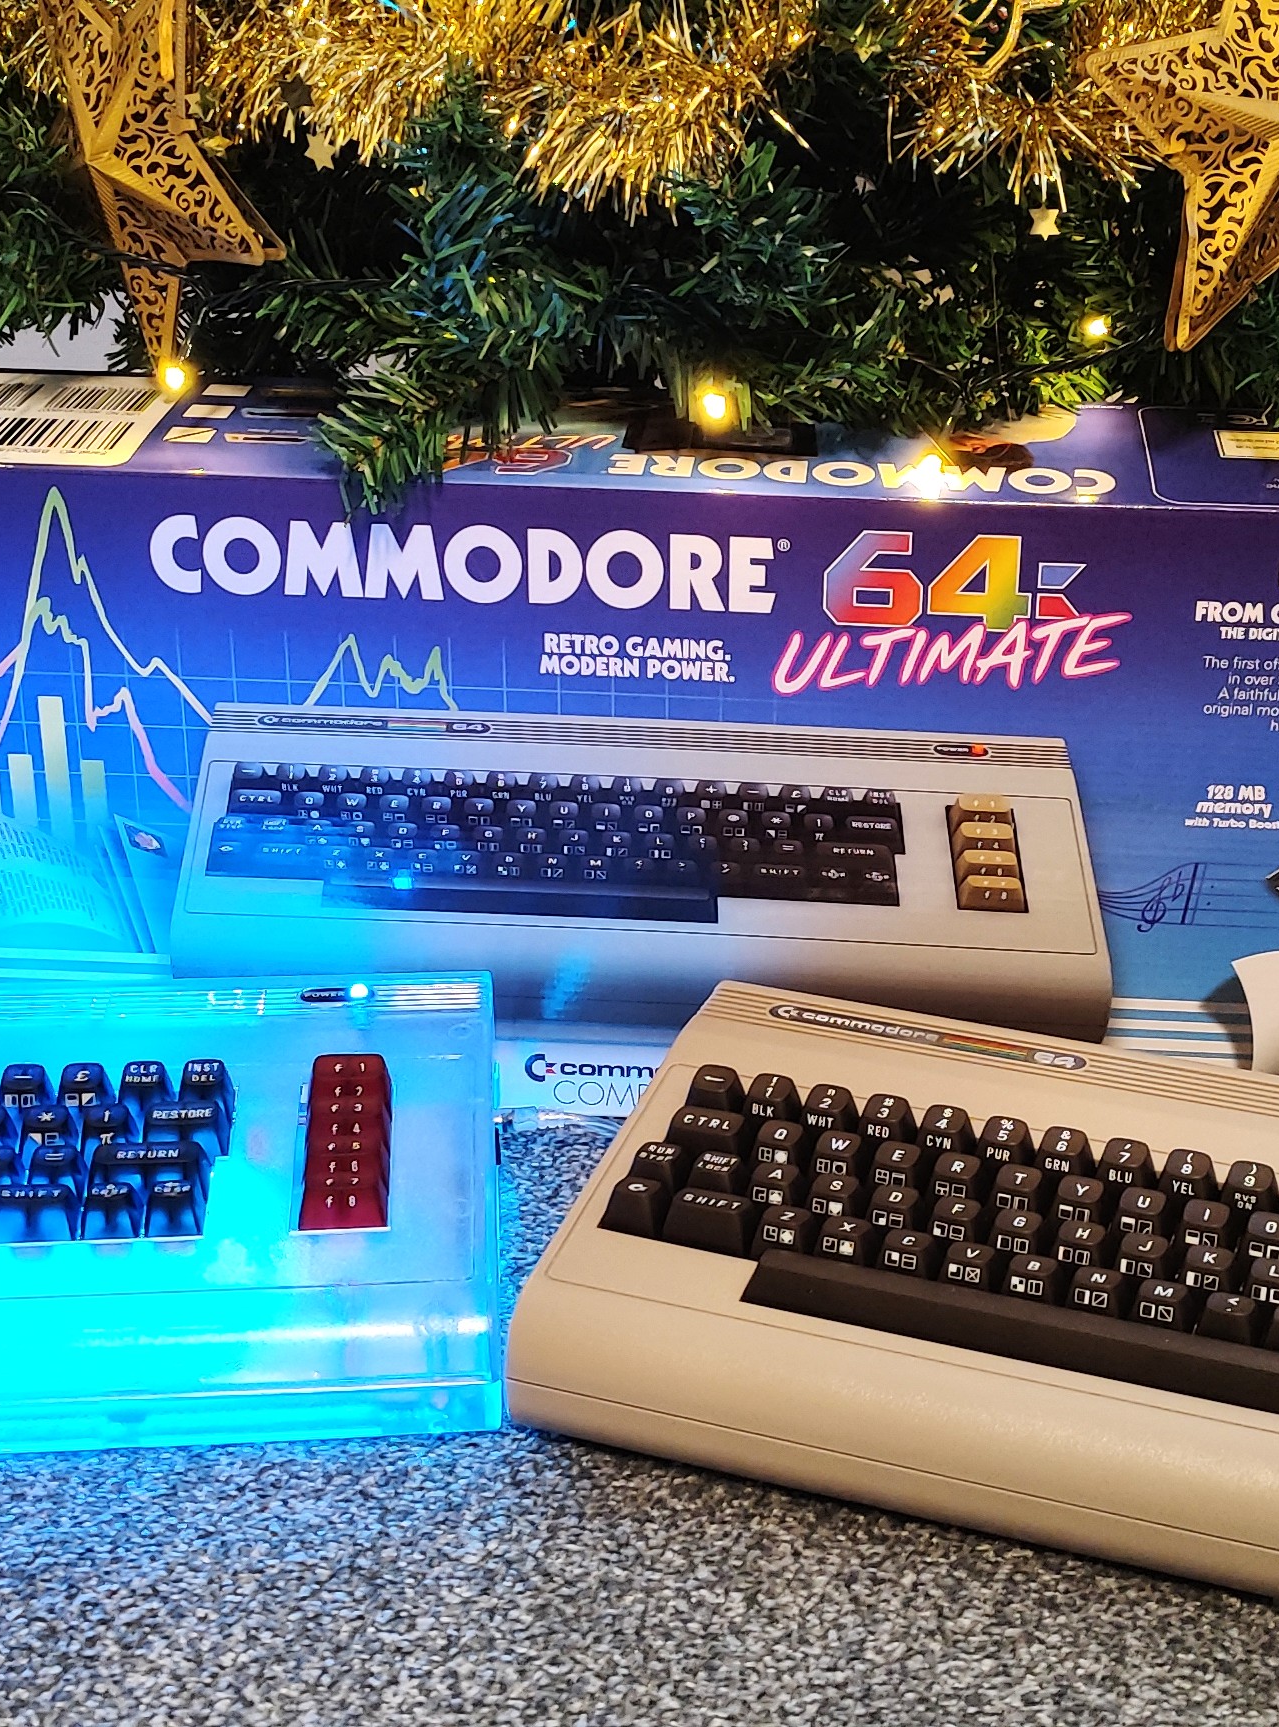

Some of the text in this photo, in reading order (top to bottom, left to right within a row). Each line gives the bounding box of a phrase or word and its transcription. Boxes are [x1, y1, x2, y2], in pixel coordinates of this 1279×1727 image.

[822, 529, 1030, 632] 64
[1195, 600, 1264, 624] FROM
[1220, 626, 1245, 640] THE
[542, 632, 733, 662] RETRO GAMING.
[771, 612, 1133, 696] ULTIMATE
[539, 654, 736, 683] MODERN POWER.
[1203, 655, 1229, 670] The
[1233, 656, 1260, 671] first
[1228, 673, 1240, 686] in
[1244, 676, 1275, 687] over
[1217, 687, 1229, 700] A
[1203, 703, 1253, 719] original
[452, 722, 486, 732] 64
[1206, 784, 1266, 801] 128 MB
[1195, 801, 1273, 819] memory
[1184, 817, 1210, 827] with
[1212, 818, 1246, 828] Turbo
[802, 1011, 1077, 1069] commodore 64
[129, 1064, 159, 1074] CLR
[187, 1063, 219, 1073] INST
[191, 1074, 216, 1083] DEL
[152, 1108, 214, 1120] RESTORE
[751, 1102, 775, 1117] BLK
[683, 1114, 731, 1131] CTRL
[806, 1113, 835, 1129] WHT
[774, 1128, 788, 1140] Q
[866, 1123, 890, 1139] RED
[831, 1137, 851, 1151] W
[926, 1134, 952, 1150] CYN
[116, 1149, 179, 1161] RETURN
[647, 1144, 676, 1155] RUN
[891, 1149, 905, 1162] E
[985, 1146, 1011, 1162] PUR
[703, 1153, 738, 1166] SHIFT
[1044, 1157, 1070, 1173] GRN
[950, 1160, 966, 1173] R
[768, 1168, 784, 1181] A
[1014, 1172, 1028, 1185] T
[1108, 1168, 1133, 1184] BLU
[829, 1180, 844, 1192] S
[1075, 1183, 1090, 1197] Y
[1172, 1179, 1195, 1196] YEL
[1, 1189, 62, 1198] SHIFT
[888, 1191, 903, 1203] D
[1234, 1192, 1257, 1204] RVS
[683, 1192, 742, 1211] SHIFT
[1137, 1195, 1151, 1209] U
[1237, 1201, 1253, 1211] ON
[950, 1203, 966, 1215] F
[779, 1211, 796, 1222] Z
[1012, 1216, 1027, 1228] G
[839, 1221, 856, 1232] X
[1075, 1227, 1092, 1240] H
[901, 1236, 916, 1247] C
[1137, 1240, 1154, 1252] J
[965, 1247, 981, 1259] V
[1202, 1252, 1218, 1265] K
[1026, 1261, 1042, 1272] B
[1089, 1272, 1107, 1284] N
[1153, 1285, 1174, 1298] M
